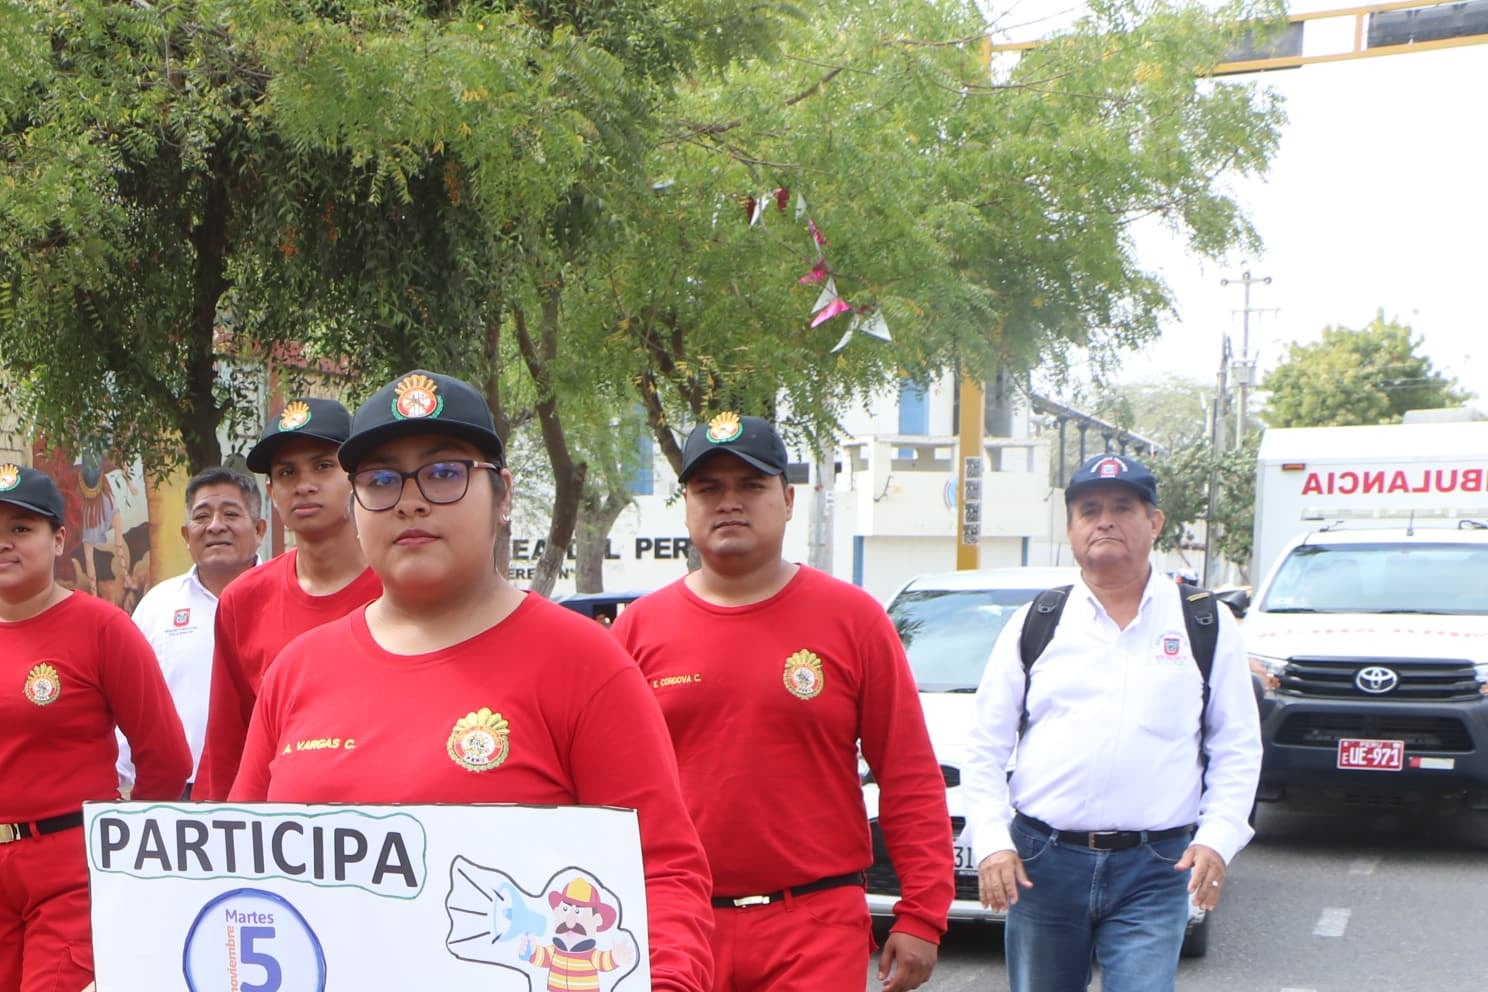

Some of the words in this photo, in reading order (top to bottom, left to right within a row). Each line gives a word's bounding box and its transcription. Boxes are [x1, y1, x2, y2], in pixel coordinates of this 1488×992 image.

[296, 738, 340, 751] VARGAS
[1349, 747, 1399, 766] UE-971
[99, 818, 418, 888] PARTICIPA
[225, 909, 274, 924] Martes
